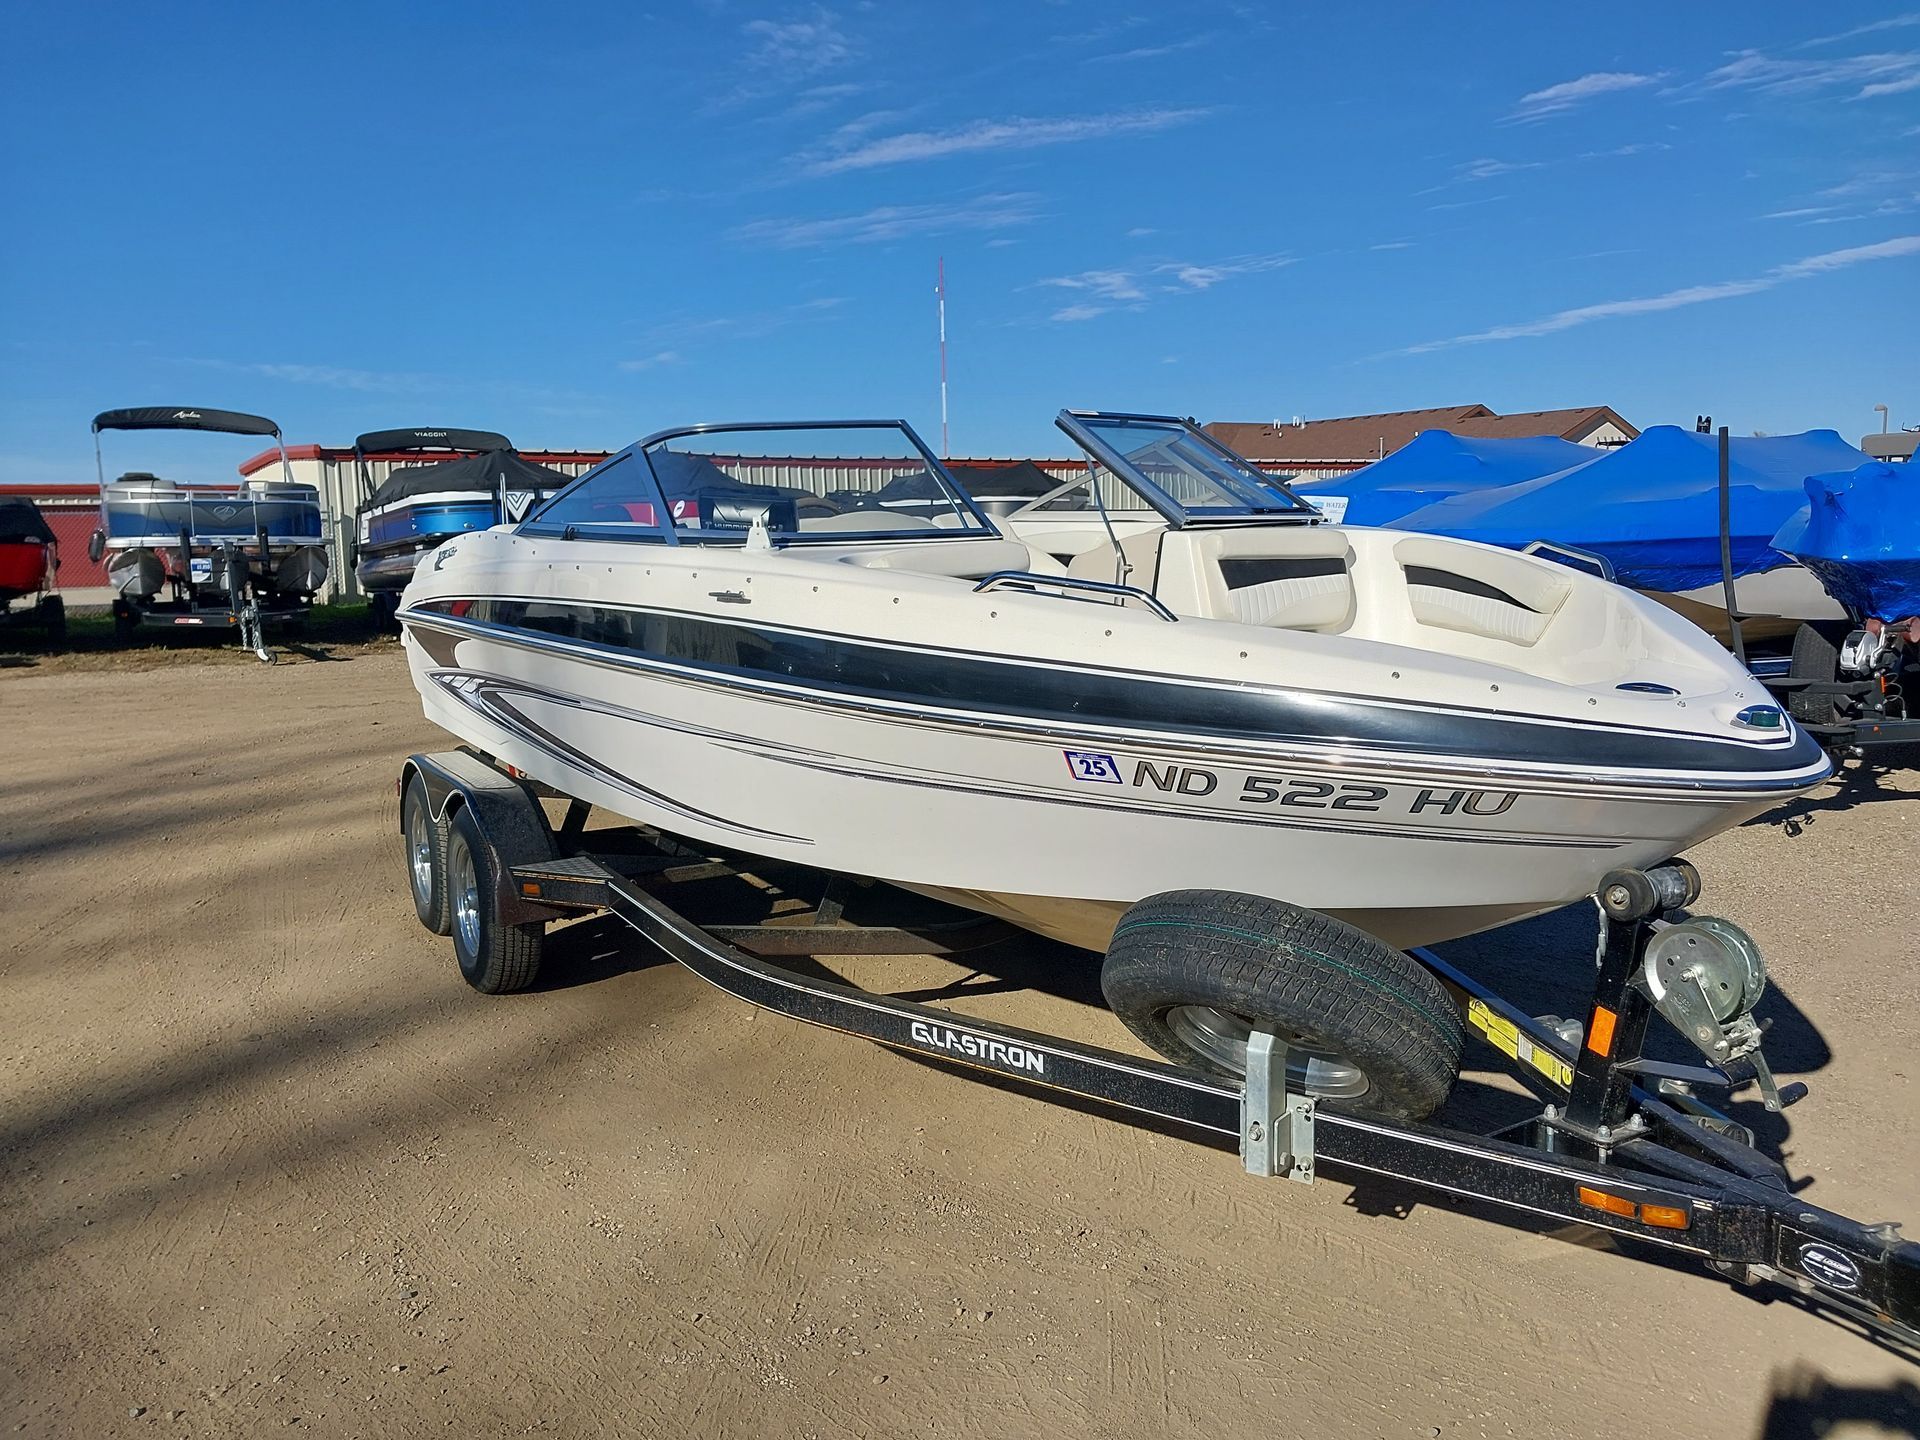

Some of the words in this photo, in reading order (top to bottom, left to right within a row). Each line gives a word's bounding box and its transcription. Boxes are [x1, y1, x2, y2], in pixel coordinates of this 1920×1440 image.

[1079, 759, 1107, 777] 25
[1132, 760, 1218, 791] ND
[1239, 775, 1389, 812] 522
[1408, 789, 1520, 816] HU
[911, 1021, 1044, 1074] GLASTRON
